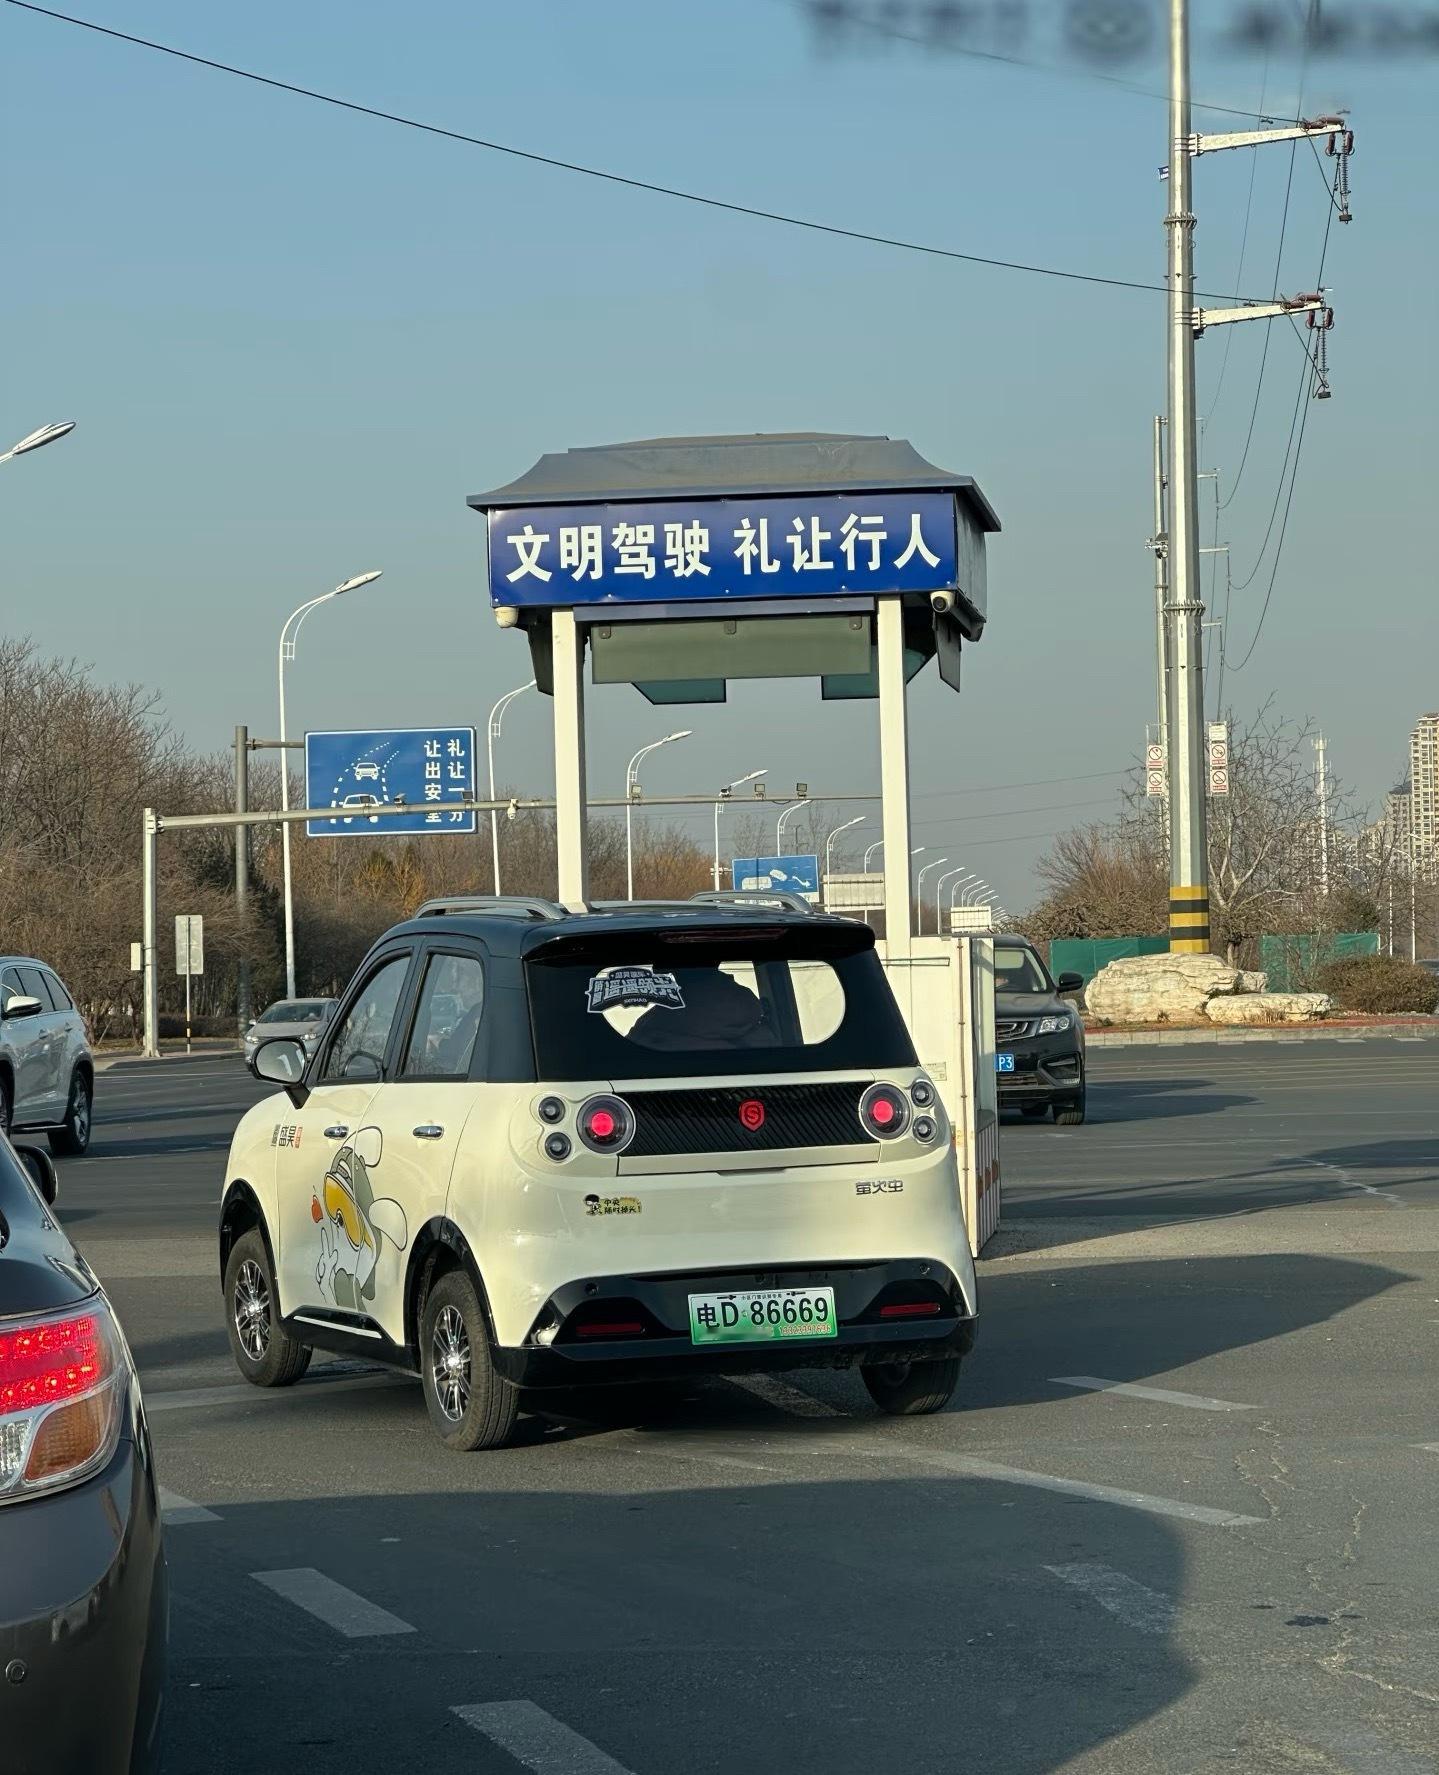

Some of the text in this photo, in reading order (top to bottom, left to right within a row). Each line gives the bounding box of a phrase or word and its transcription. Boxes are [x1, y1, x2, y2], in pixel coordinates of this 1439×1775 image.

[505, 512, 942, 583] 文明驾驶 礼让行人
